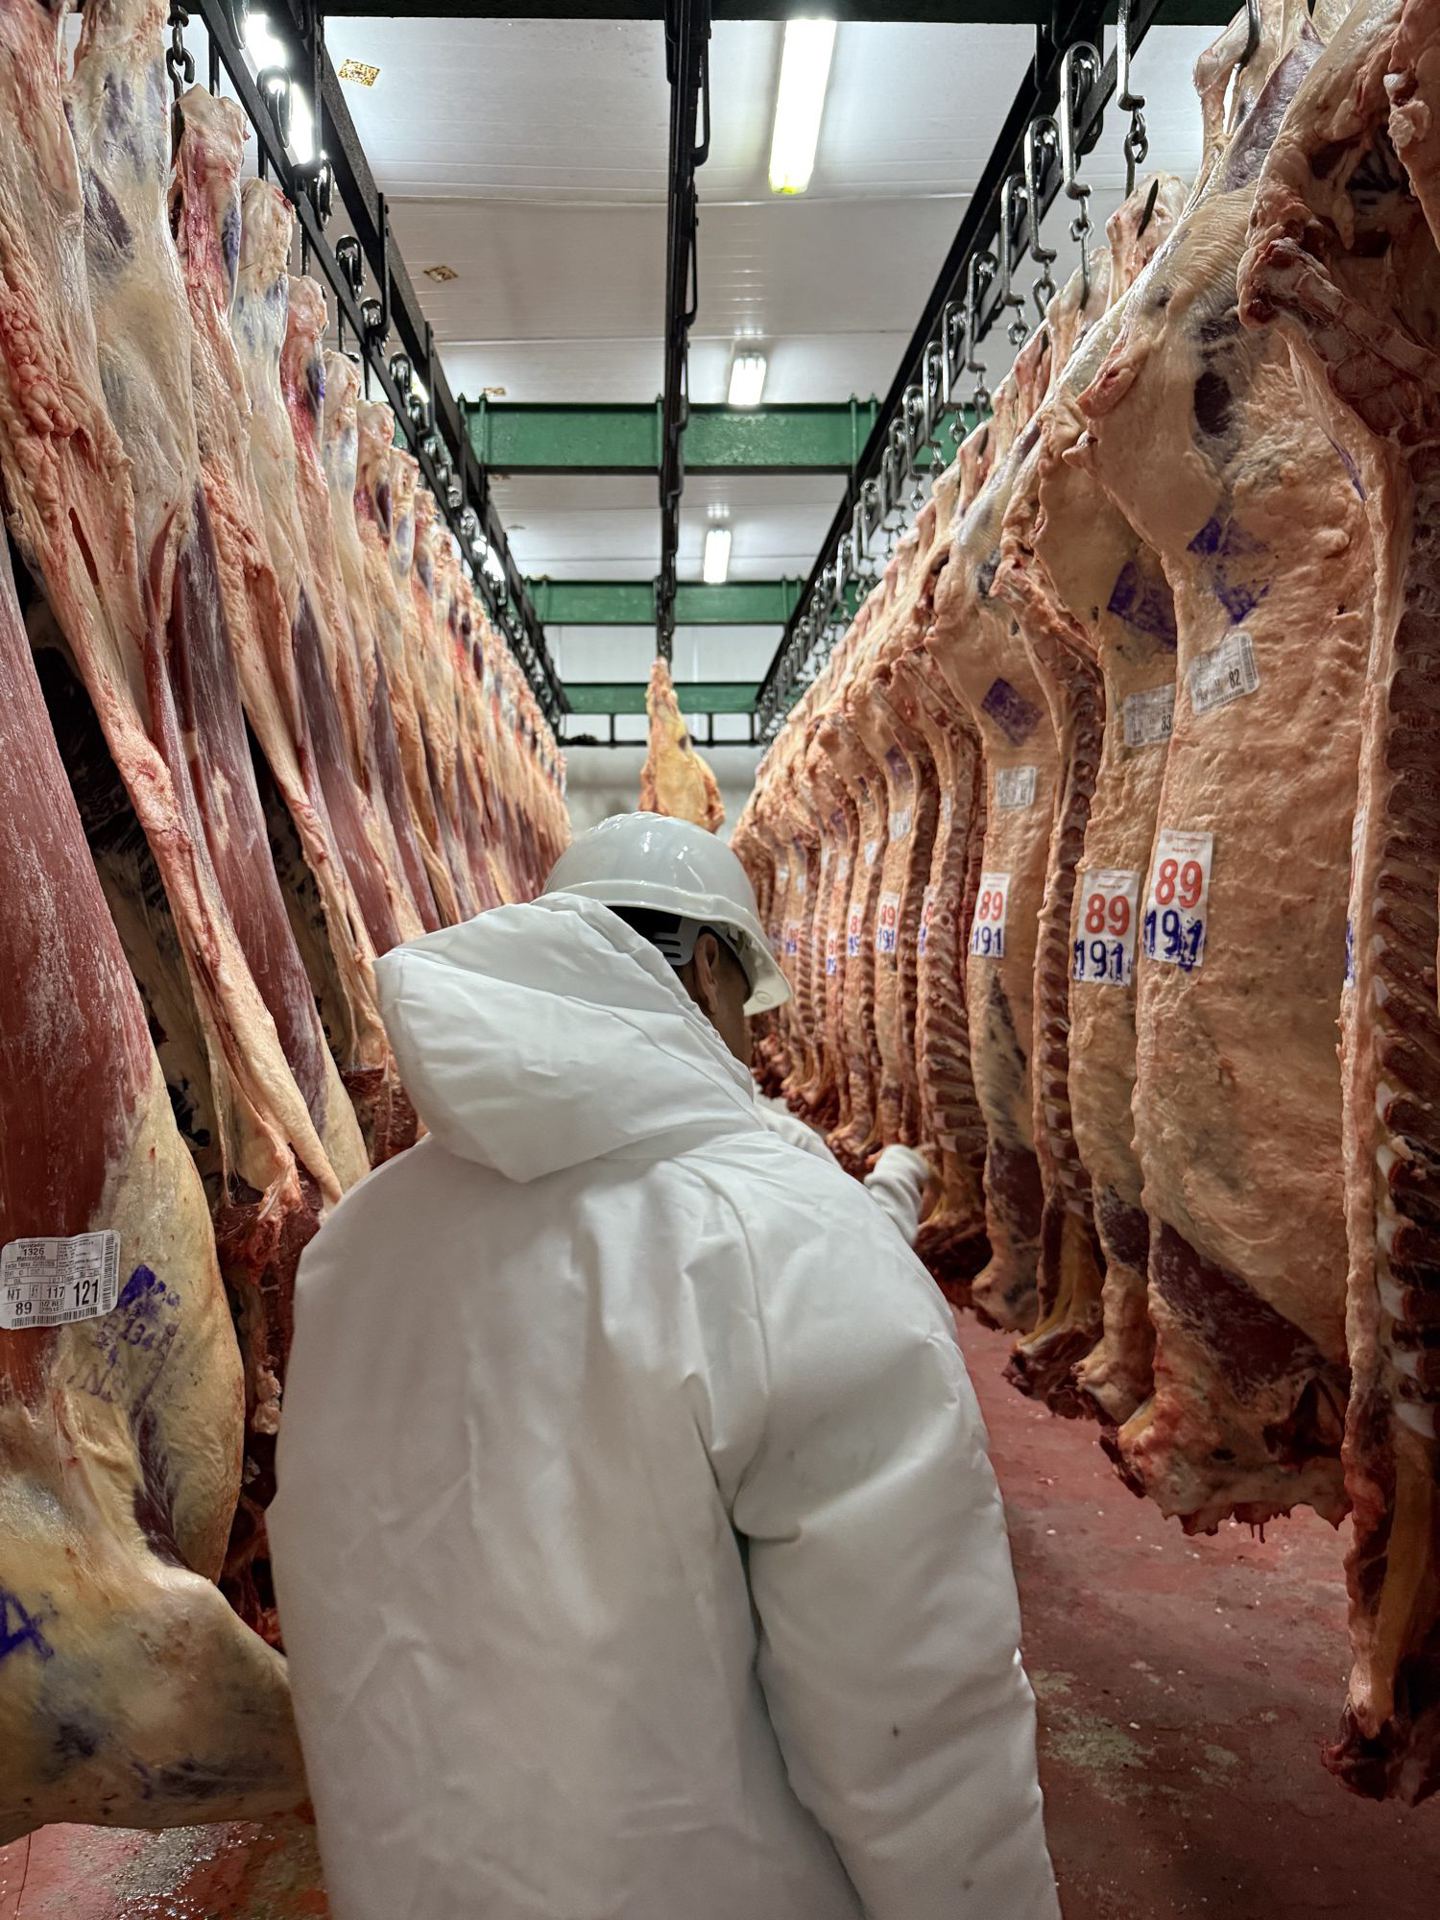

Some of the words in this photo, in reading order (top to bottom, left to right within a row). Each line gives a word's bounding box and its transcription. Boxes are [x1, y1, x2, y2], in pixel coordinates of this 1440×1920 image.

[1229, 668, 1241, 688] 82
[1155, 859, 1202, 908] 89
[979, 891, 1003, 921] 89
[1085, 893, 1130, 936] 89
[973, 926, 1002, 955] 191
[1144, 909, 1203, 964] 191
[1073, 939, 1124, 982] 191
[23, 1248, 45, 1256] 1326
[46, 1286, 65, 1299] 117
[73, 1279, 99, 1307] 121
[15, 1301, 32, 1316] 89
